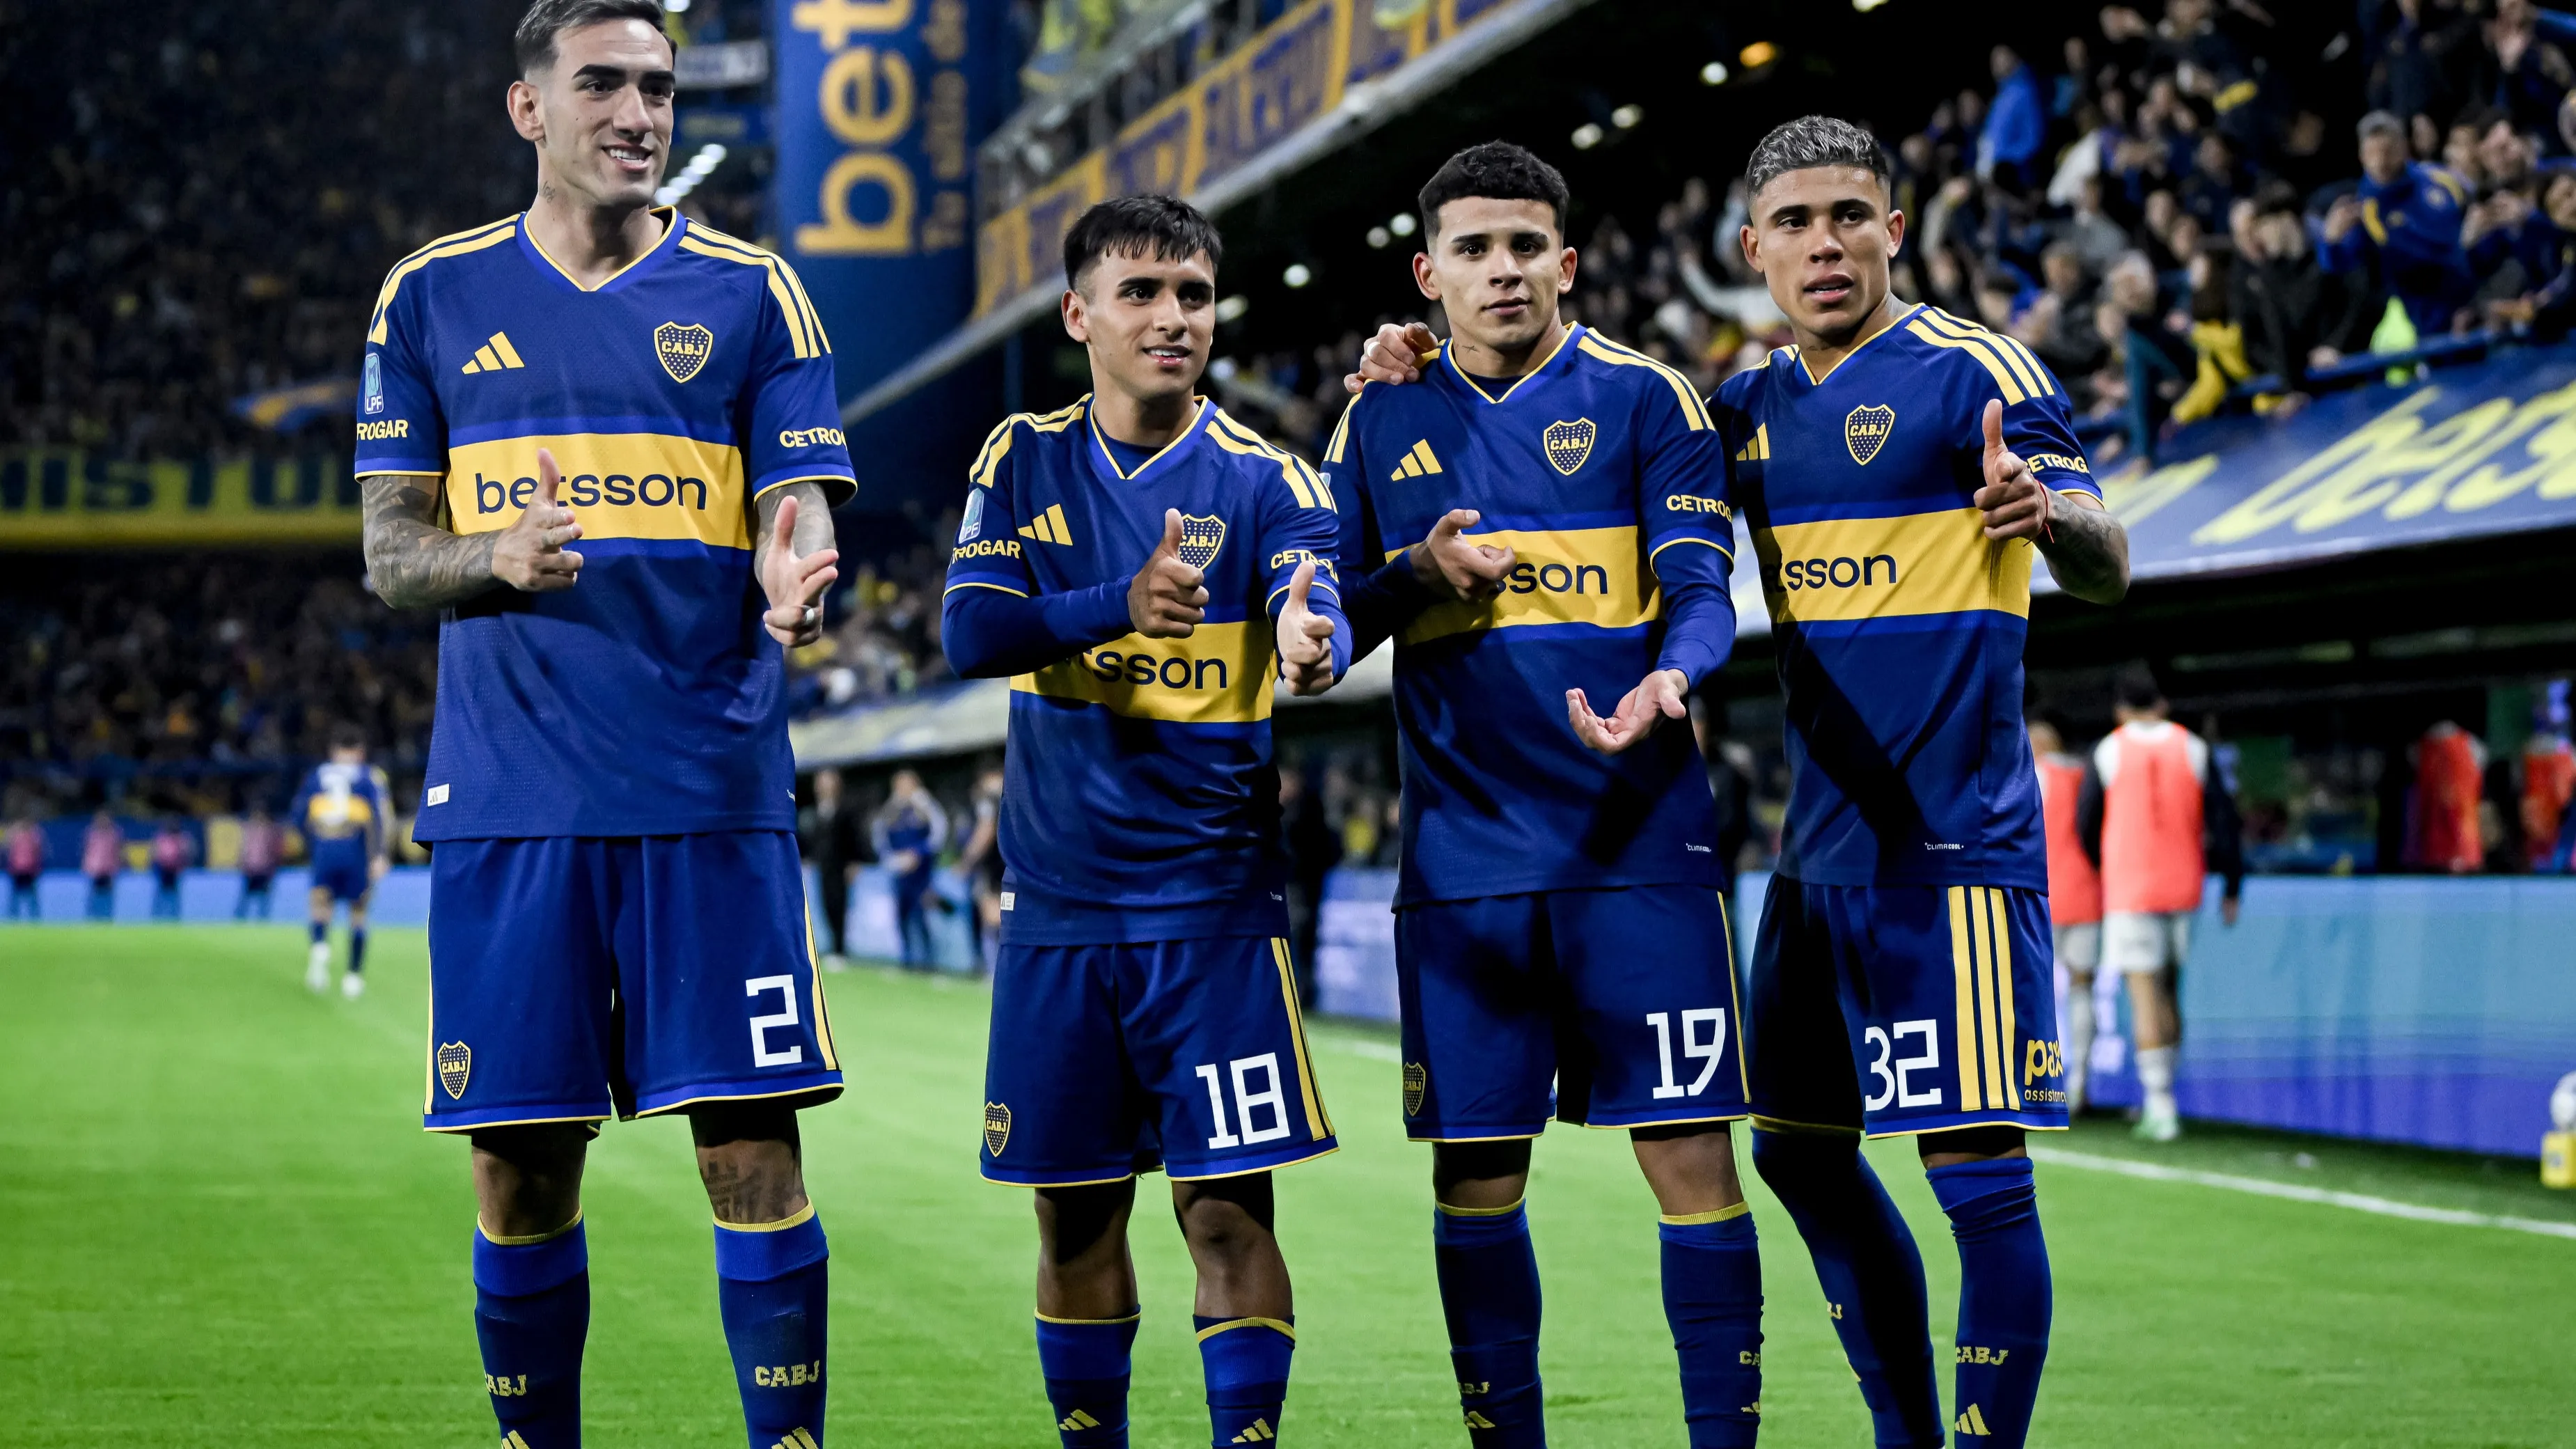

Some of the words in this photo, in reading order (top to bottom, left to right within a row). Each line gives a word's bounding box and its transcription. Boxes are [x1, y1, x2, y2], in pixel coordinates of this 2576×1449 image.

[662, 341, 704, 355] CABJ
[366, 395, 382, 412] LPF
[356, 420, 408, 440] ROGAR
[1851, 424, 1886, 437] CABJ
[1550, 437, 1589, 451] CABJ
[2025, 453, 2090, 473] ETROG
[961, 522, 980, 539] PF
[1084, 649, 1227, 689] sson
[746, 974, 802, 1067] 2
[1647, 1008, 1726, 1099] 19
[441, 1060, 466, 1073] CABJ
[1865, 1019, 1942, 1111] 32
[1195, 1052, 1290, 1149] 18
[987, 1120, 1007, 1132] CABJ
[755, 1360, 819, 1387] CABJ
[485, 1373, 526, 1397] ABJ
